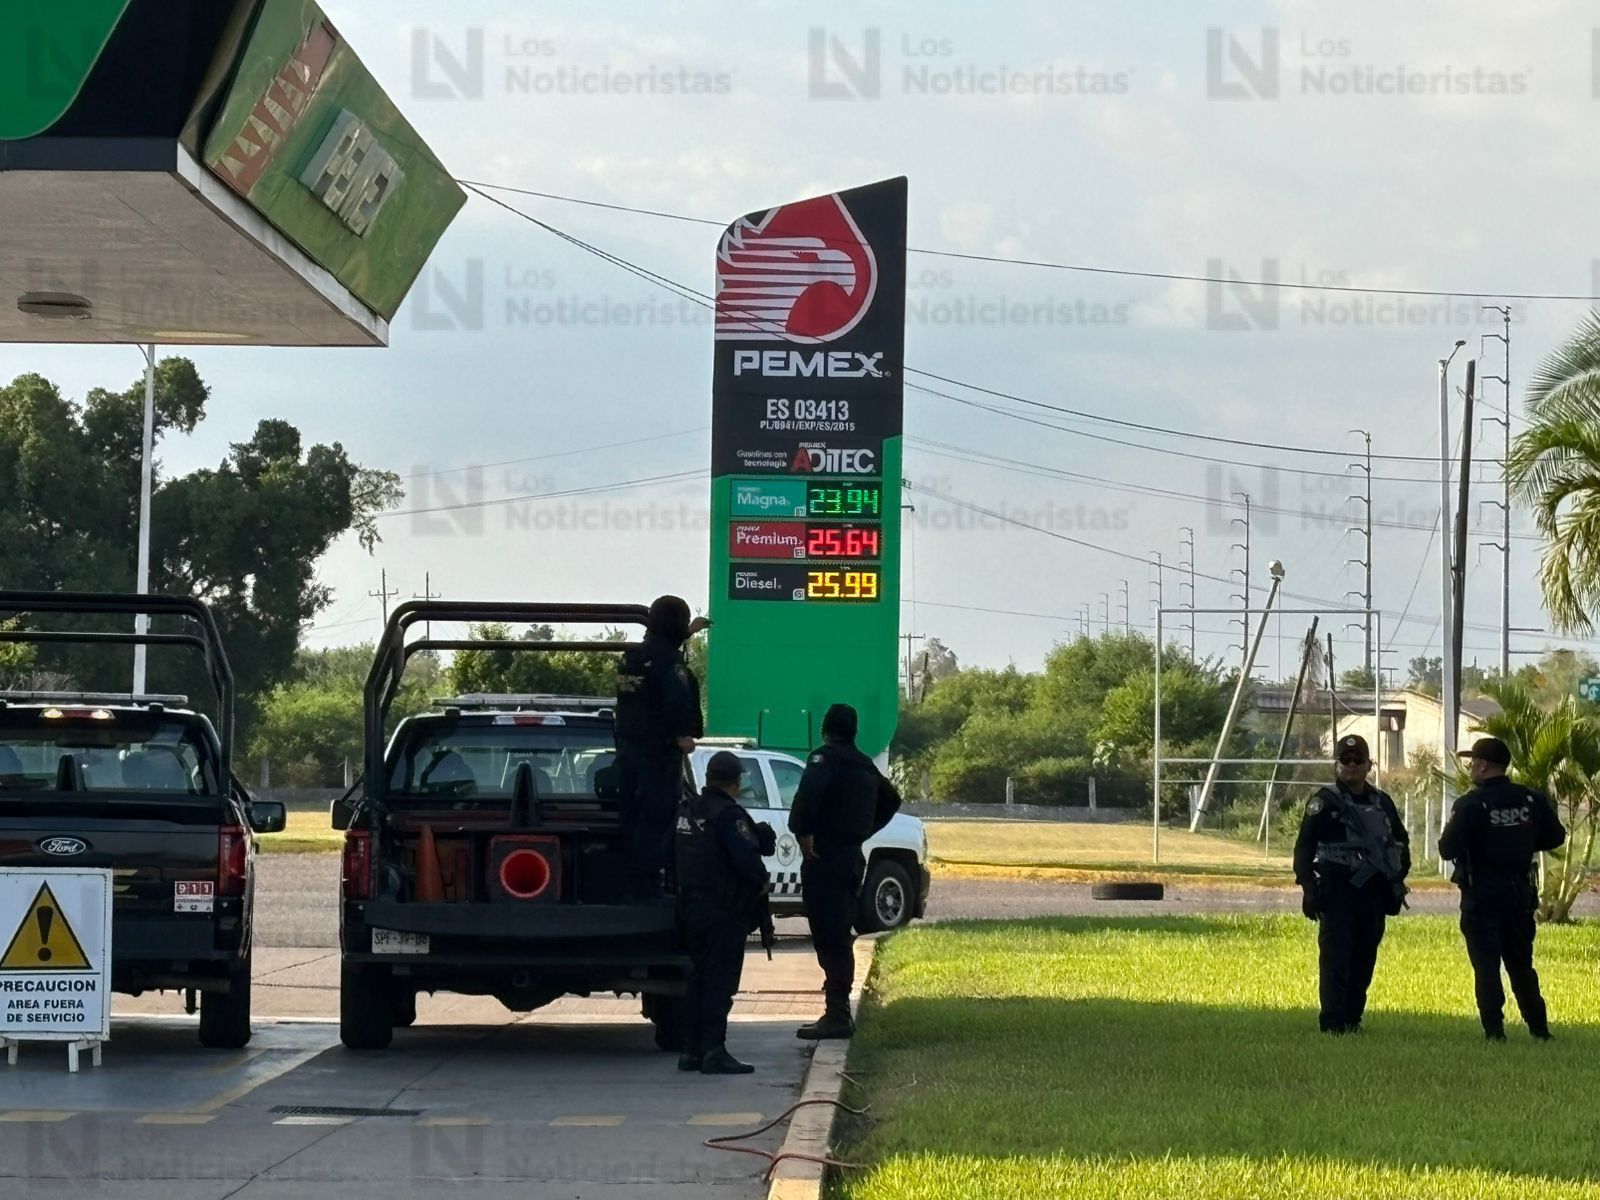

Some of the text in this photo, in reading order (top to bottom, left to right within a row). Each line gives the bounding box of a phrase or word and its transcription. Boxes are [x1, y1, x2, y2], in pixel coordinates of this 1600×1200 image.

[734, 350, 884, 380] PEMEX
[767, 399, 849, 420] ES 03413
[738, 492, 786, 509] Magna
[809, 489, 879, 514] 23.94
[736, 531, 798, 545] Premium
[808, 529, 878, 556] 25.64
[736, 577, 777, 589] Diesel
[808, 571, 877, 597] 25.99
[1489, 806, 1529, 824] SSPC
[47, 839, 78, 853] Ford
[178, 883, 209, 894] 911
[7, 999, 84, 1009] AREA FUERA
[6, 1013, 85, 1023] DE SERVICIO
